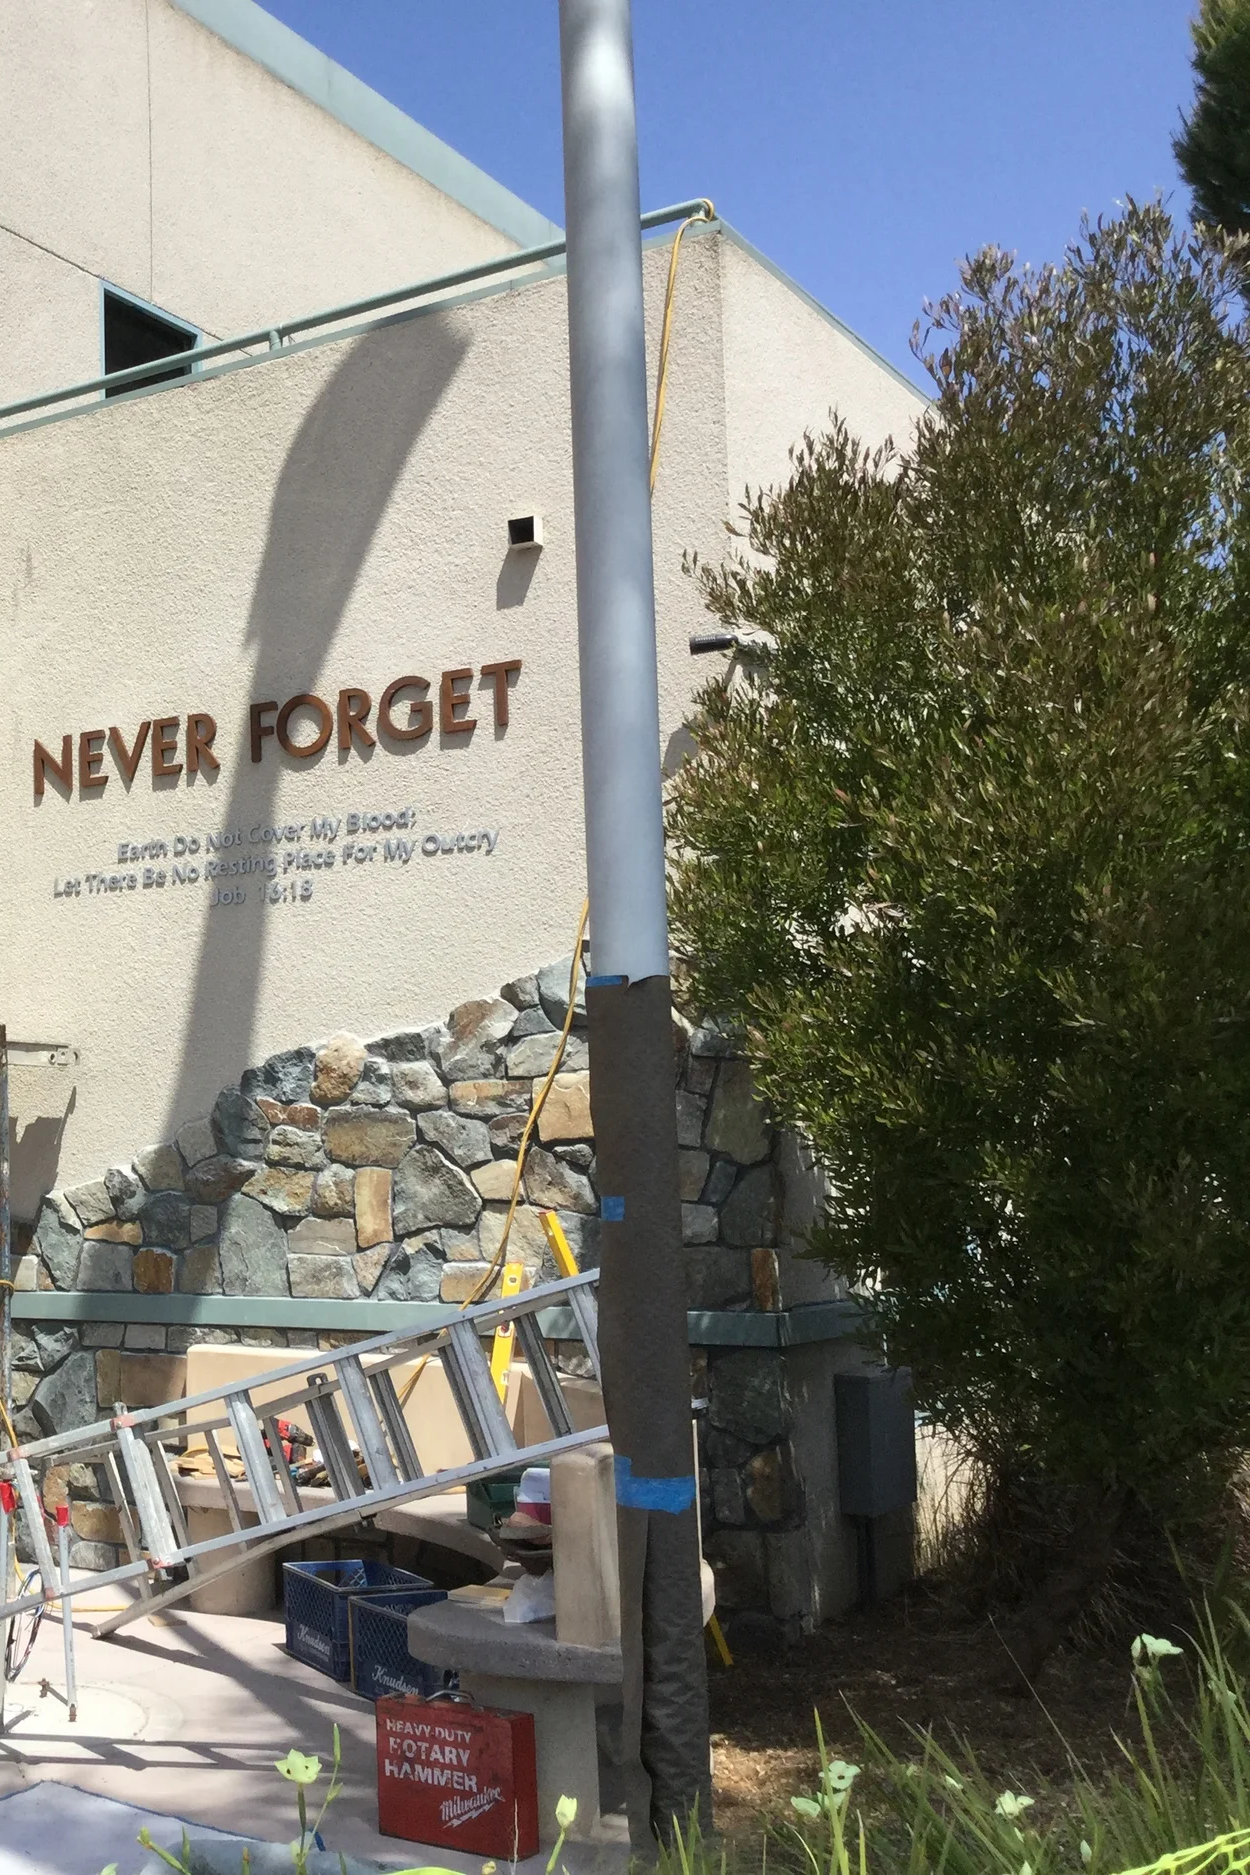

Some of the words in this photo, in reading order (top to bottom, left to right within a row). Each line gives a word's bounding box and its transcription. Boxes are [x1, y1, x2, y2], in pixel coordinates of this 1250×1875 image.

[34, 713, 221, 795] NEVER
[250, 659, 522, 764] FORGET
[117, 838, 168, 861] Earth
[174, 836, 200, 855] Do
[206, 829, 242, 852] Not
[250, 823, 305, 843] Cover
[310, 816, 341, 841] My
[346, 807, 416, 832] Blood;
[54, 877, 81, 897] Let
[85, 872, 137, 893] There
[143, 867, 166, 888] Be
[172, 865, 199, 885] No
[205, 854, 277, 879] Resting
[283, 849, 335, 872] Place
[342, 843, 377, 863] For
[384, 837, 417, 861] My
[422, 828, 499, 856] Outcry
[212, 886, 246, 907] Job
[259, 878, 313, 902] 16:18
[297, 1623, 330, 1656] Knudsen
[371, 1665, 419, 1695] Knudsen
[386, 1718, 471, 1743] HEAVY-DUTY
[389, 1736, 470, 1767] ROTARY
[384, 1759, 478, 1792] HAMMER
[439, 1786, 505, 1821] Milwaukee
